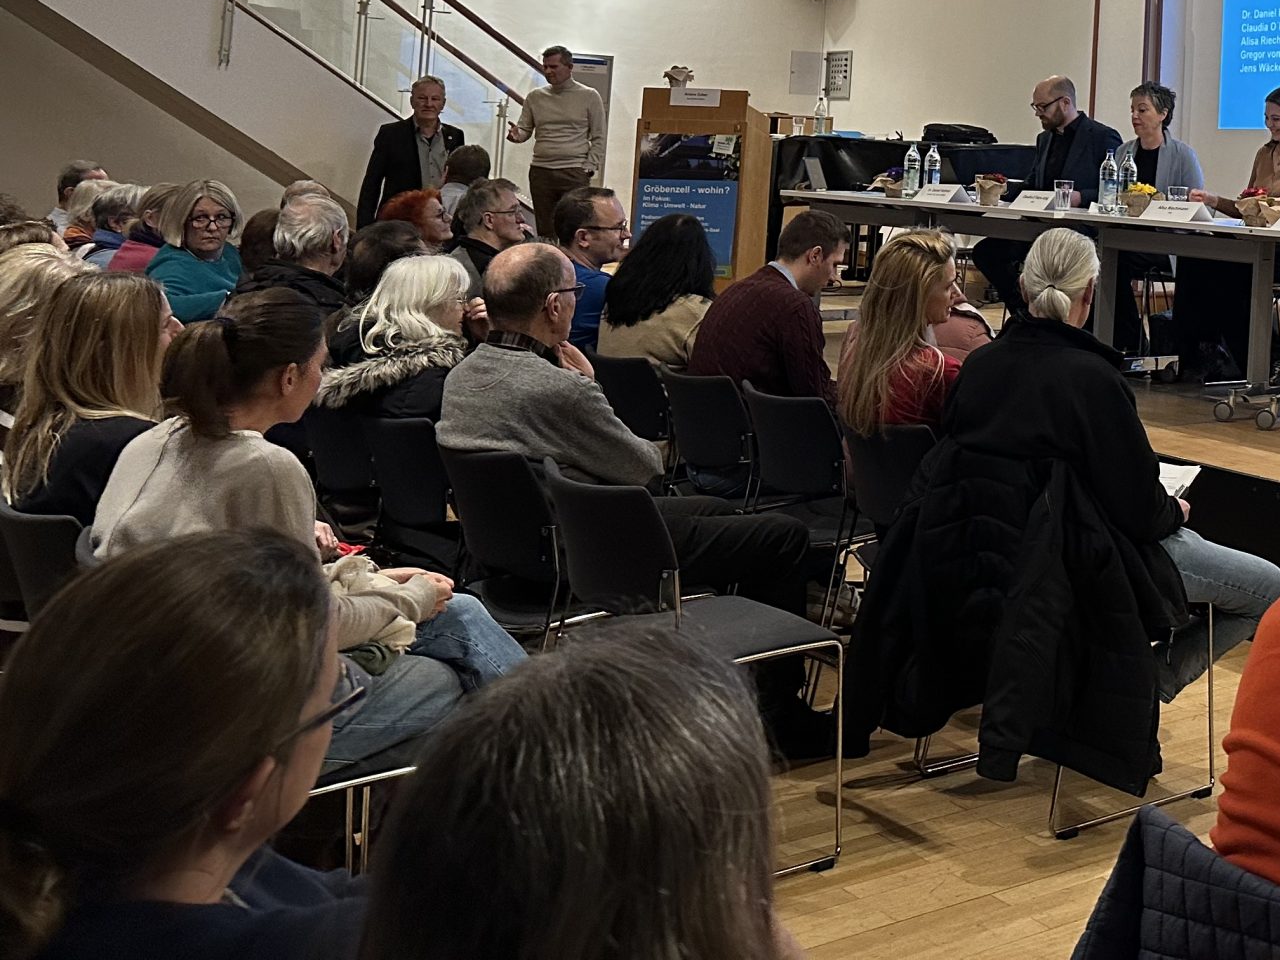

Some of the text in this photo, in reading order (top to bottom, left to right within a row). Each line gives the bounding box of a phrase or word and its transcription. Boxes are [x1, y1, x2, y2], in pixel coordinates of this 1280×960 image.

[1254, 8, 1277, 19] Daniel
[1241, 22, 1268, 33] Claudia
[1240, 36, 1259, 46] Alisa
[1240, 50, 1265, 61] Gregor
[1267, 50, 1280, 58] von
[1239, 63, 1257, 73] Jens
[643, 184, 690, 194] Gröbenzell
[698, 186, 730, 195] wohin?
